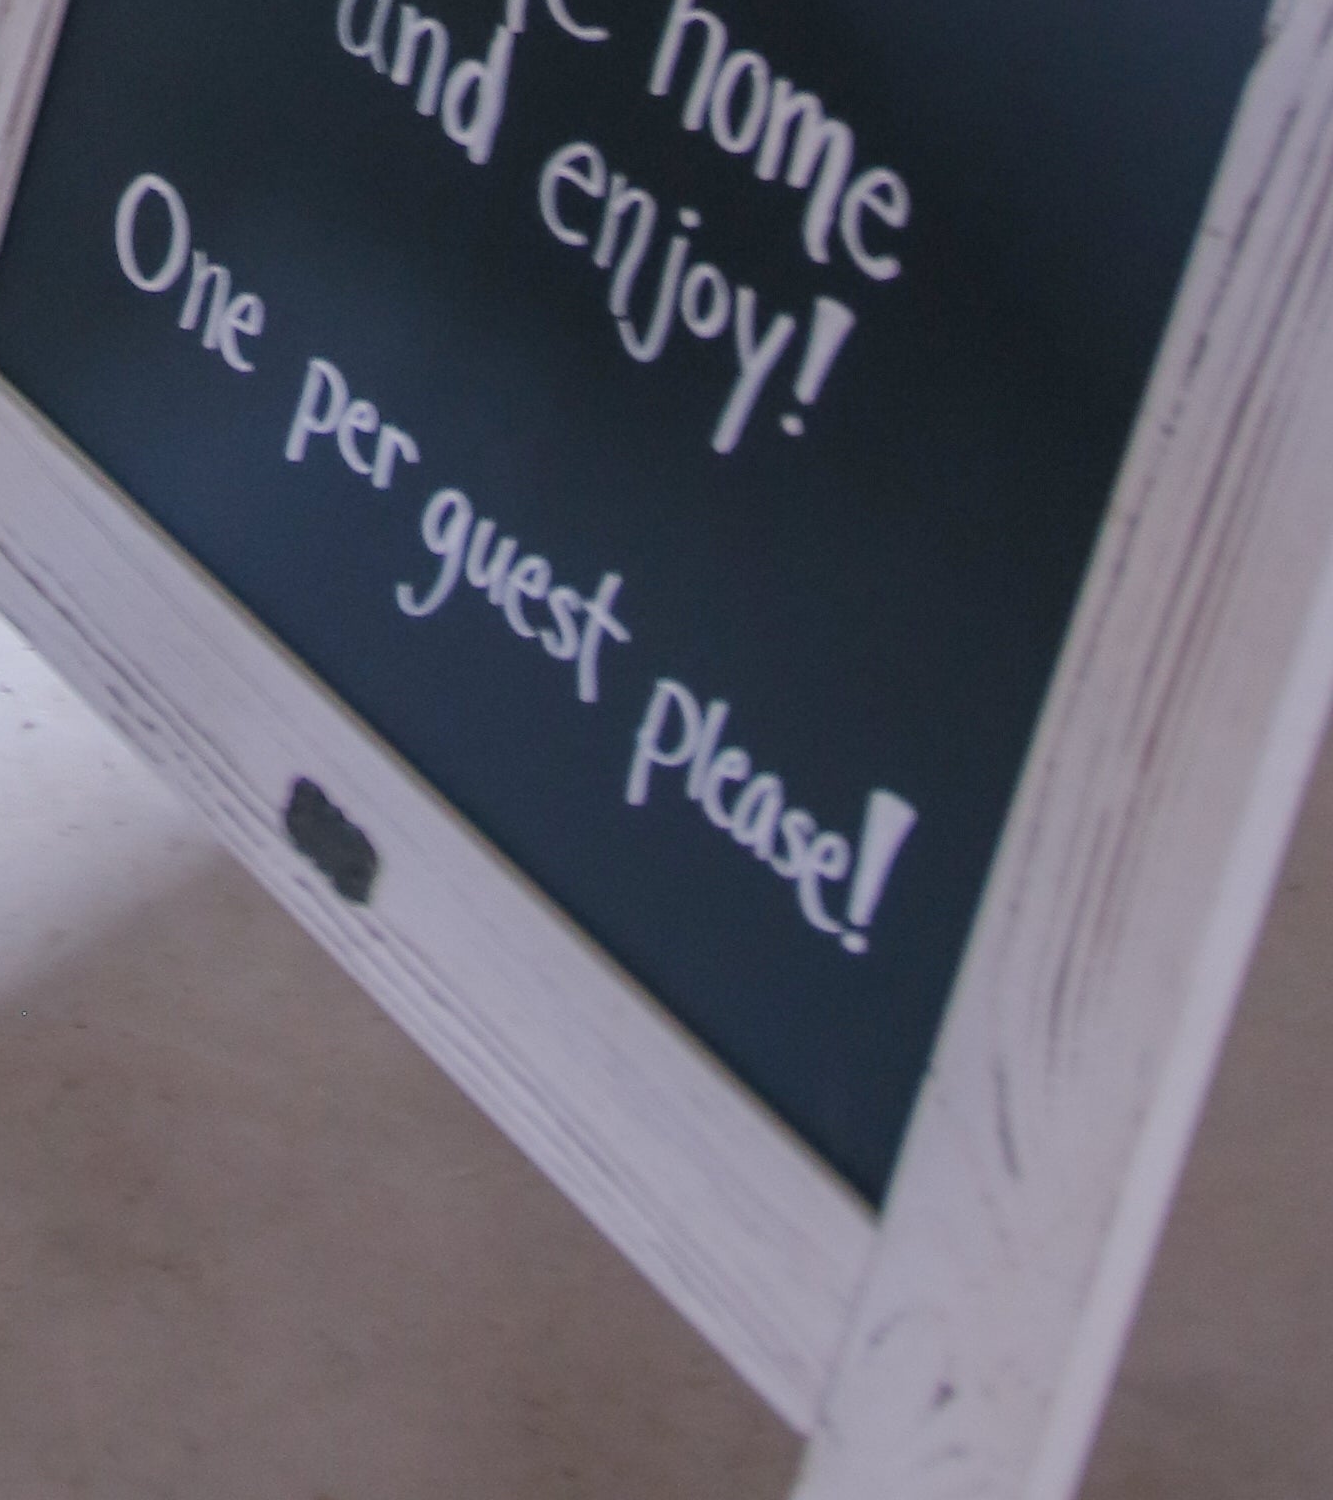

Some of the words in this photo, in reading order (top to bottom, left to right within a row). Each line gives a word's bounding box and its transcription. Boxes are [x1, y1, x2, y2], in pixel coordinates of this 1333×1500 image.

[113, 171, 266, 374] One
[283, 355, 421, 490] per
[394, 486, 632, 704] guest
[624, 676, 918, 955] please!
[537, 140, 857, 455] enjoy!
